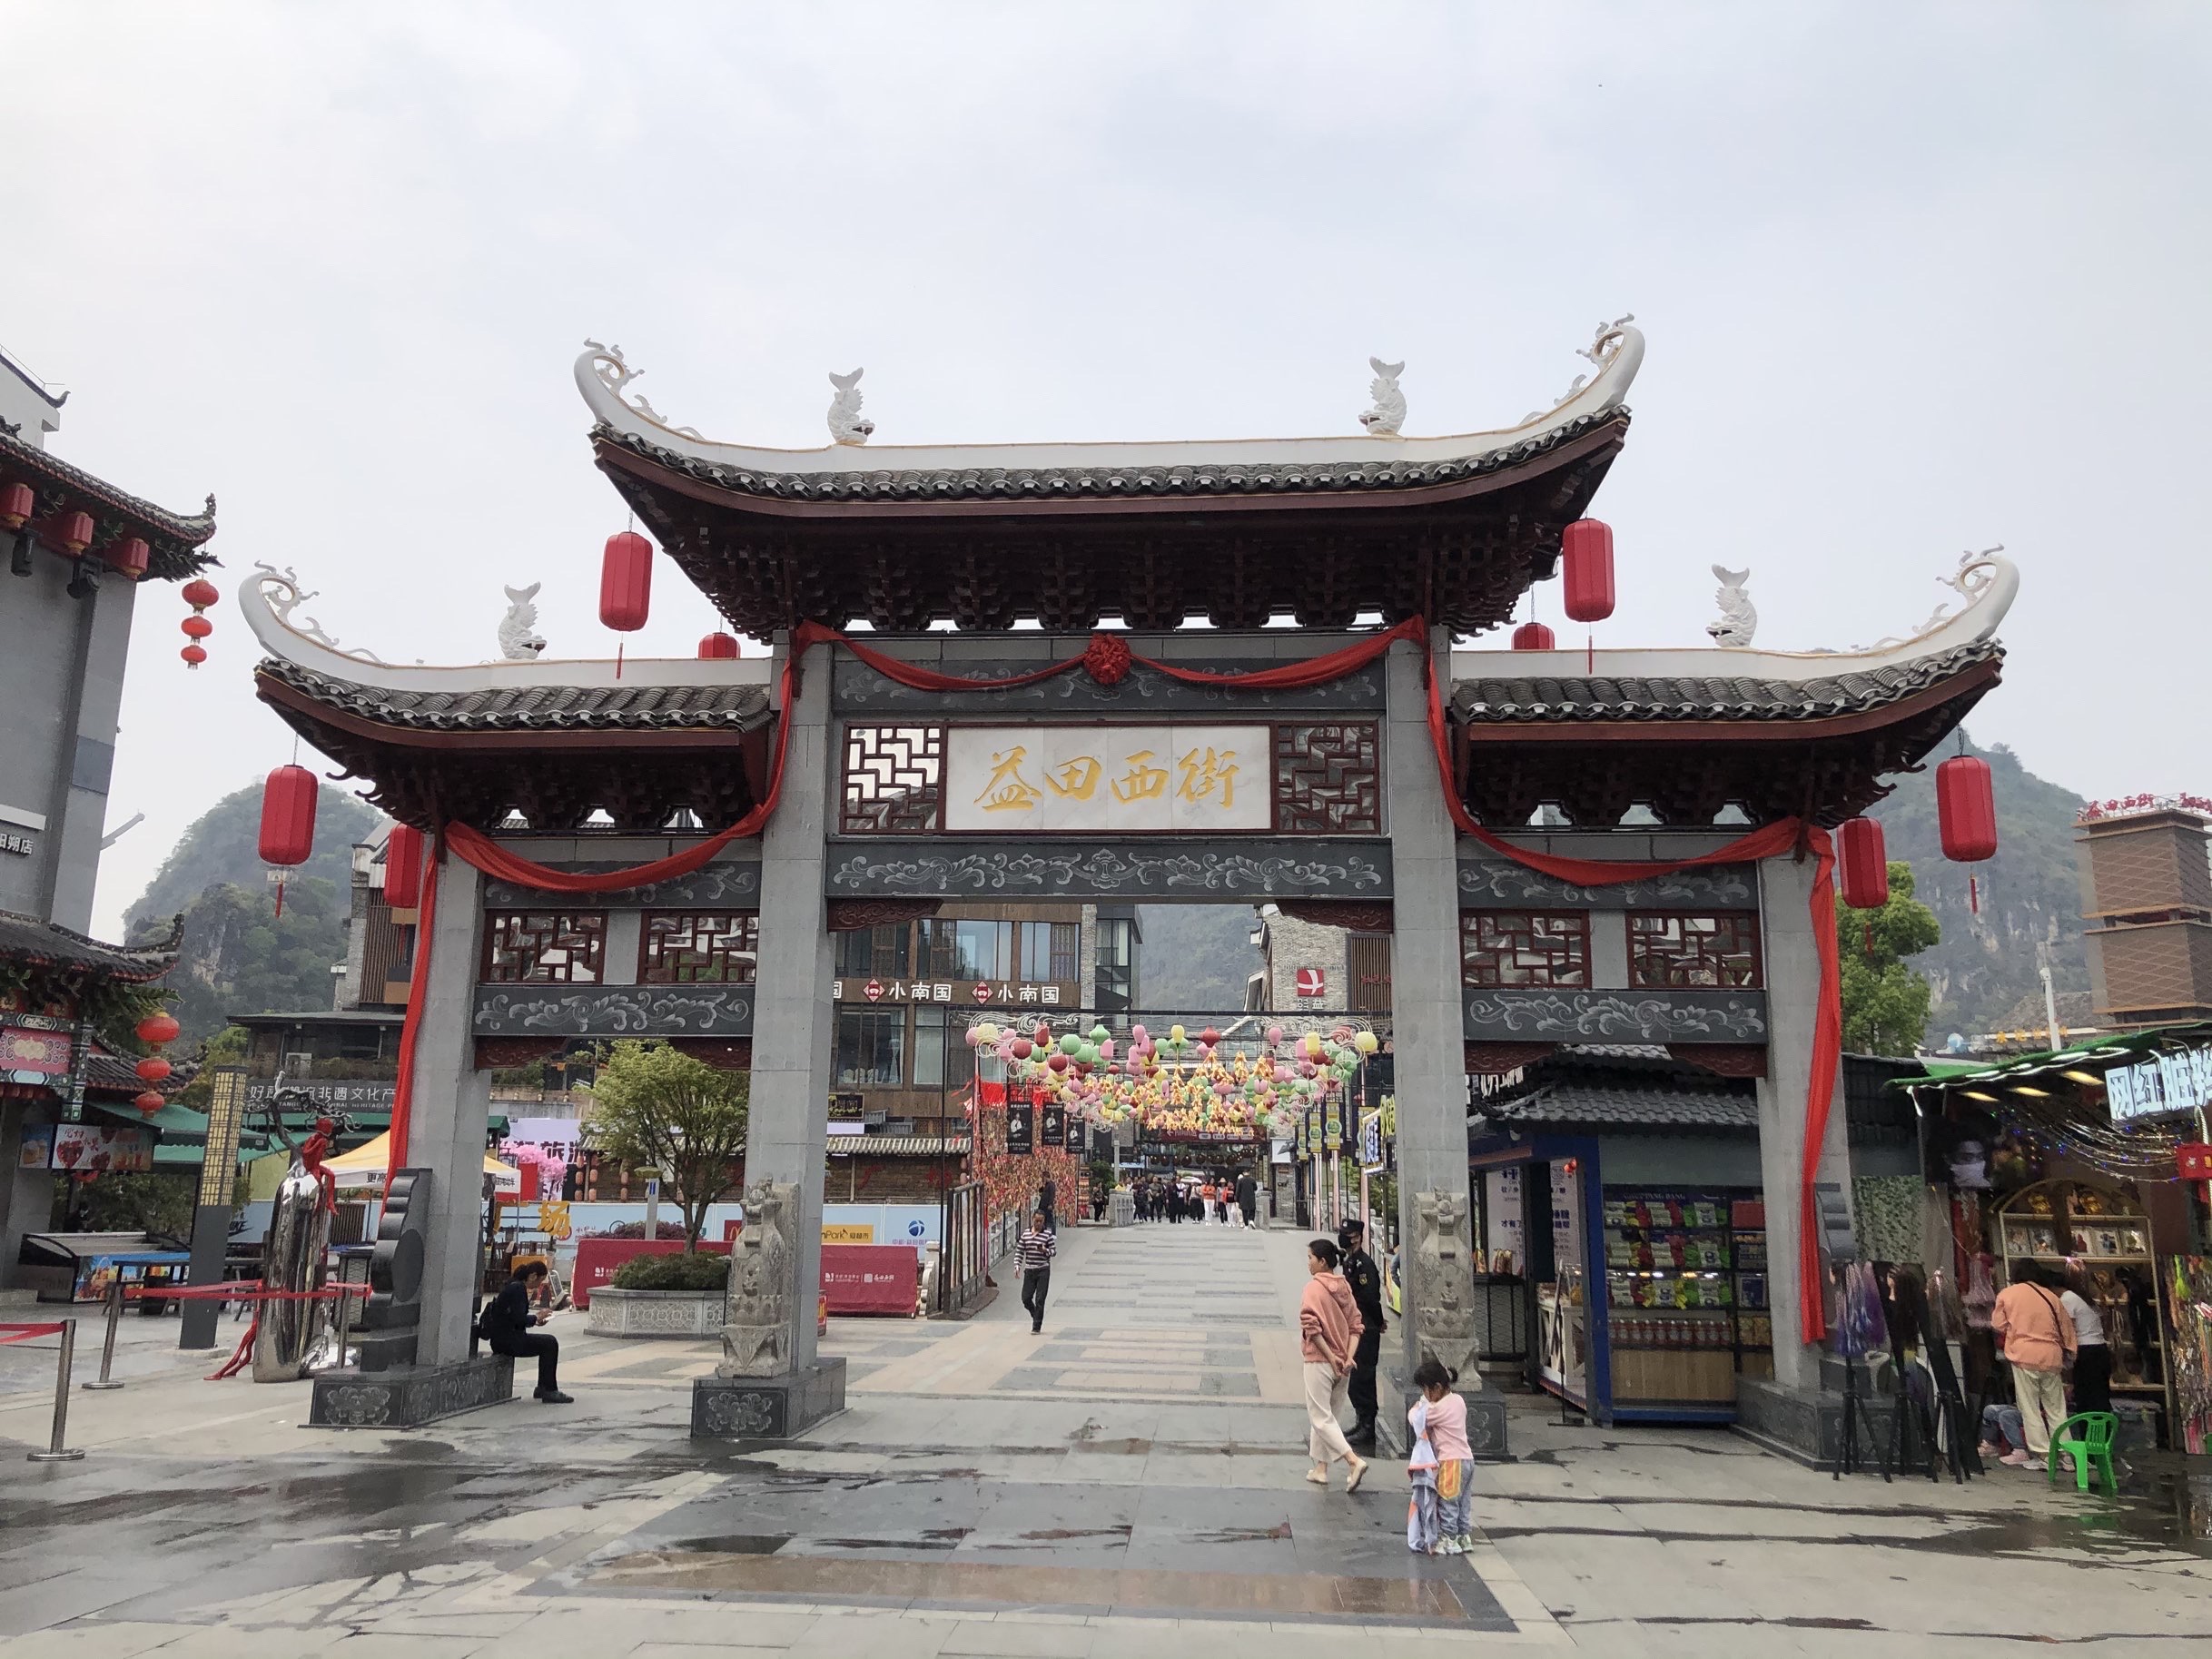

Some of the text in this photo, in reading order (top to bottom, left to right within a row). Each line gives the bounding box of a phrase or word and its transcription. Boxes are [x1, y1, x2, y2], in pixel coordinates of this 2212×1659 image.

[973, 746, 1240, 811] 益田西街
[889, 981, 952, 1002] 小南国
[998, 983, 1060, 1003] 小南国
[493, 1200, 570, 1236] 广场
